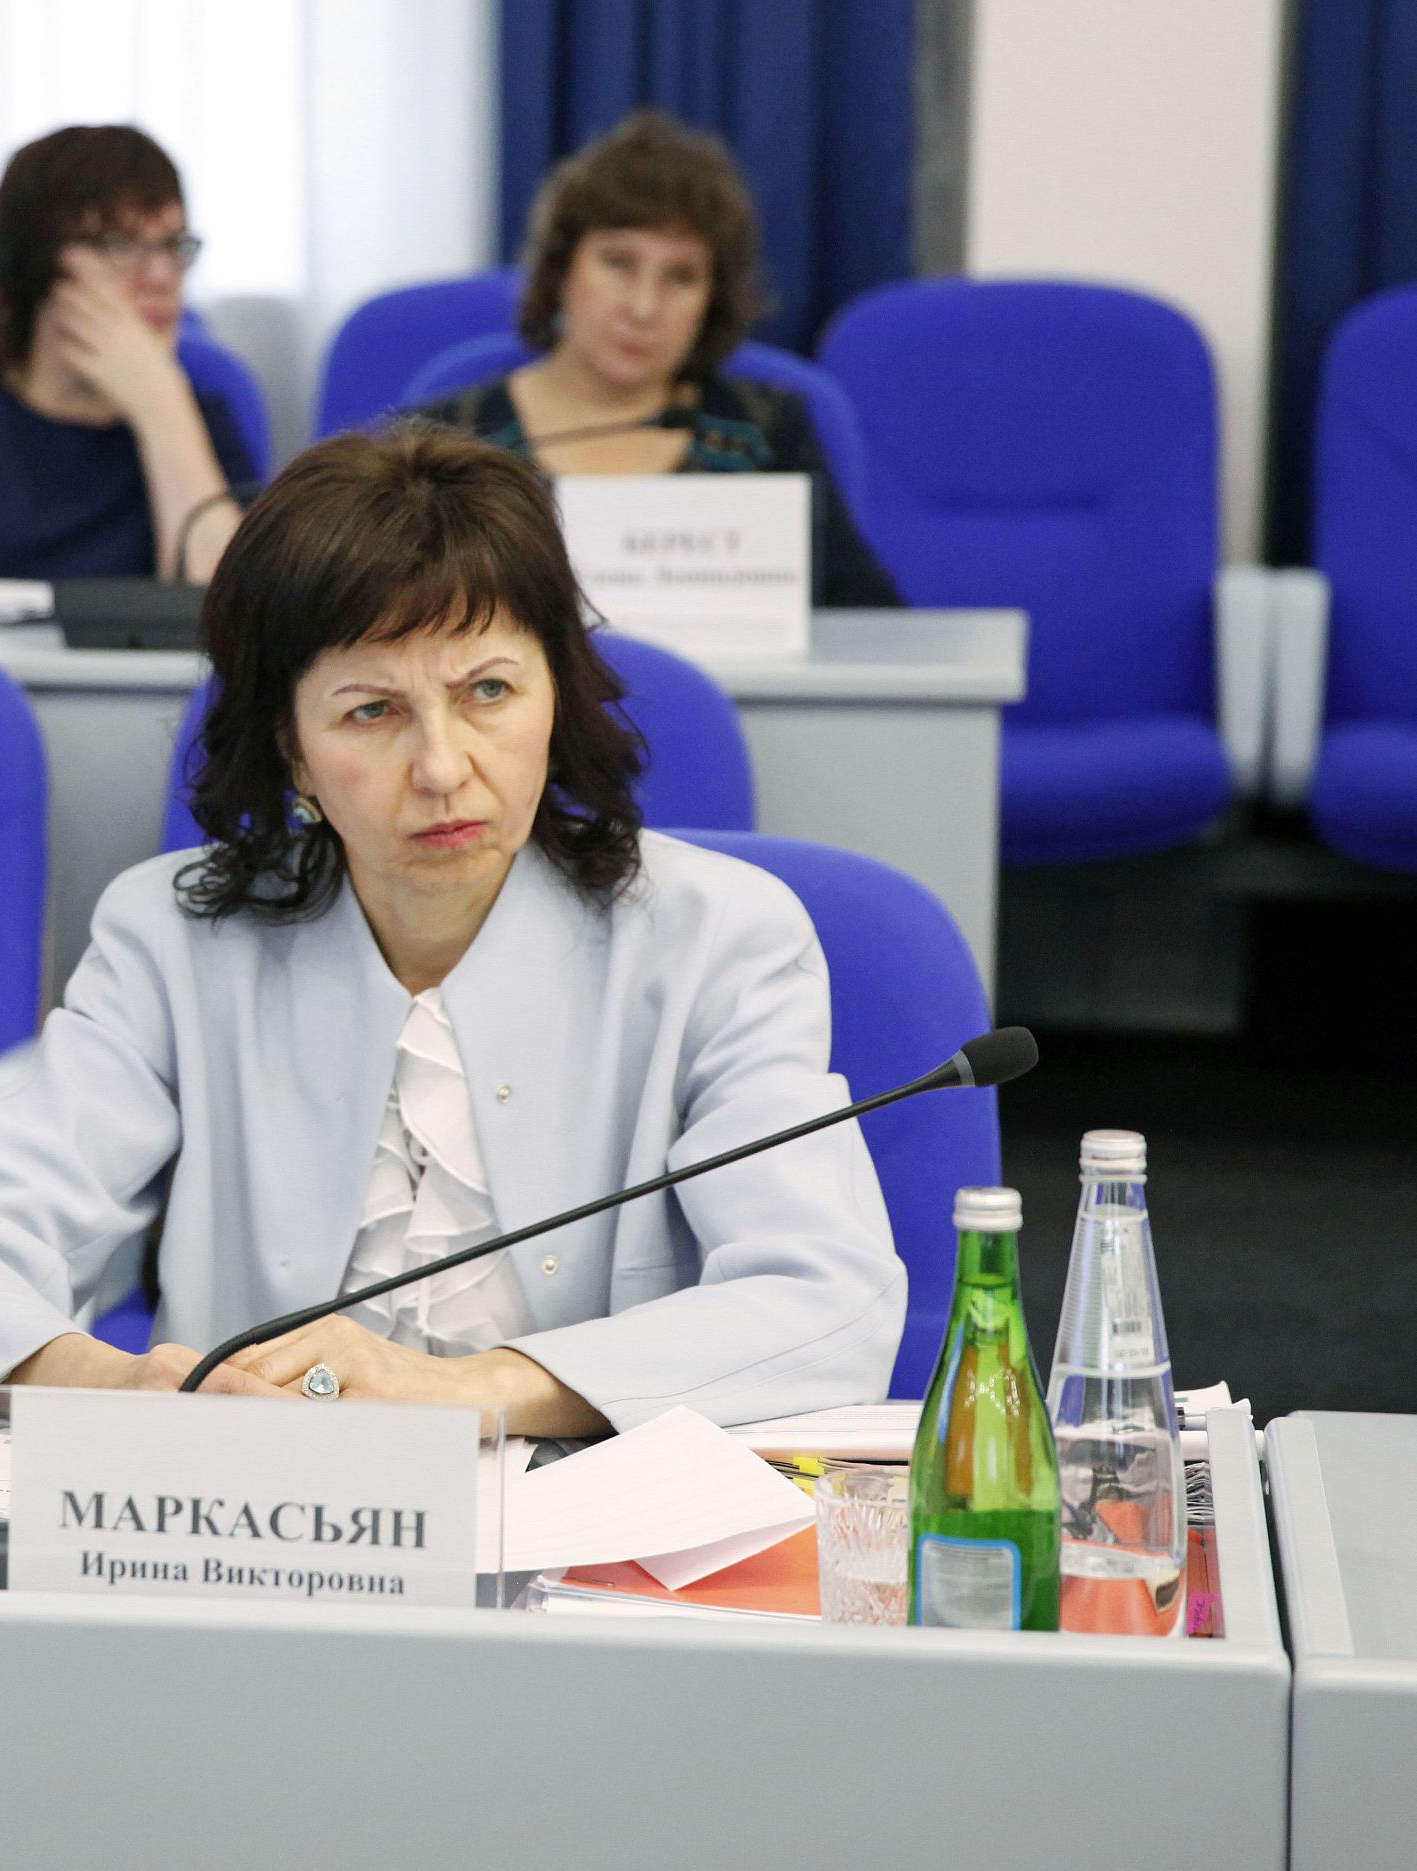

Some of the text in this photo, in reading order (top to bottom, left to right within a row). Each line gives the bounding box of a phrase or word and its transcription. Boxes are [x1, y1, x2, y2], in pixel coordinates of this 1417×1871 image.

[60, 1490, 427, 1549] МАРКАСЬЯН
[80, 1551, 407, 1597] Ирина Викторовна
